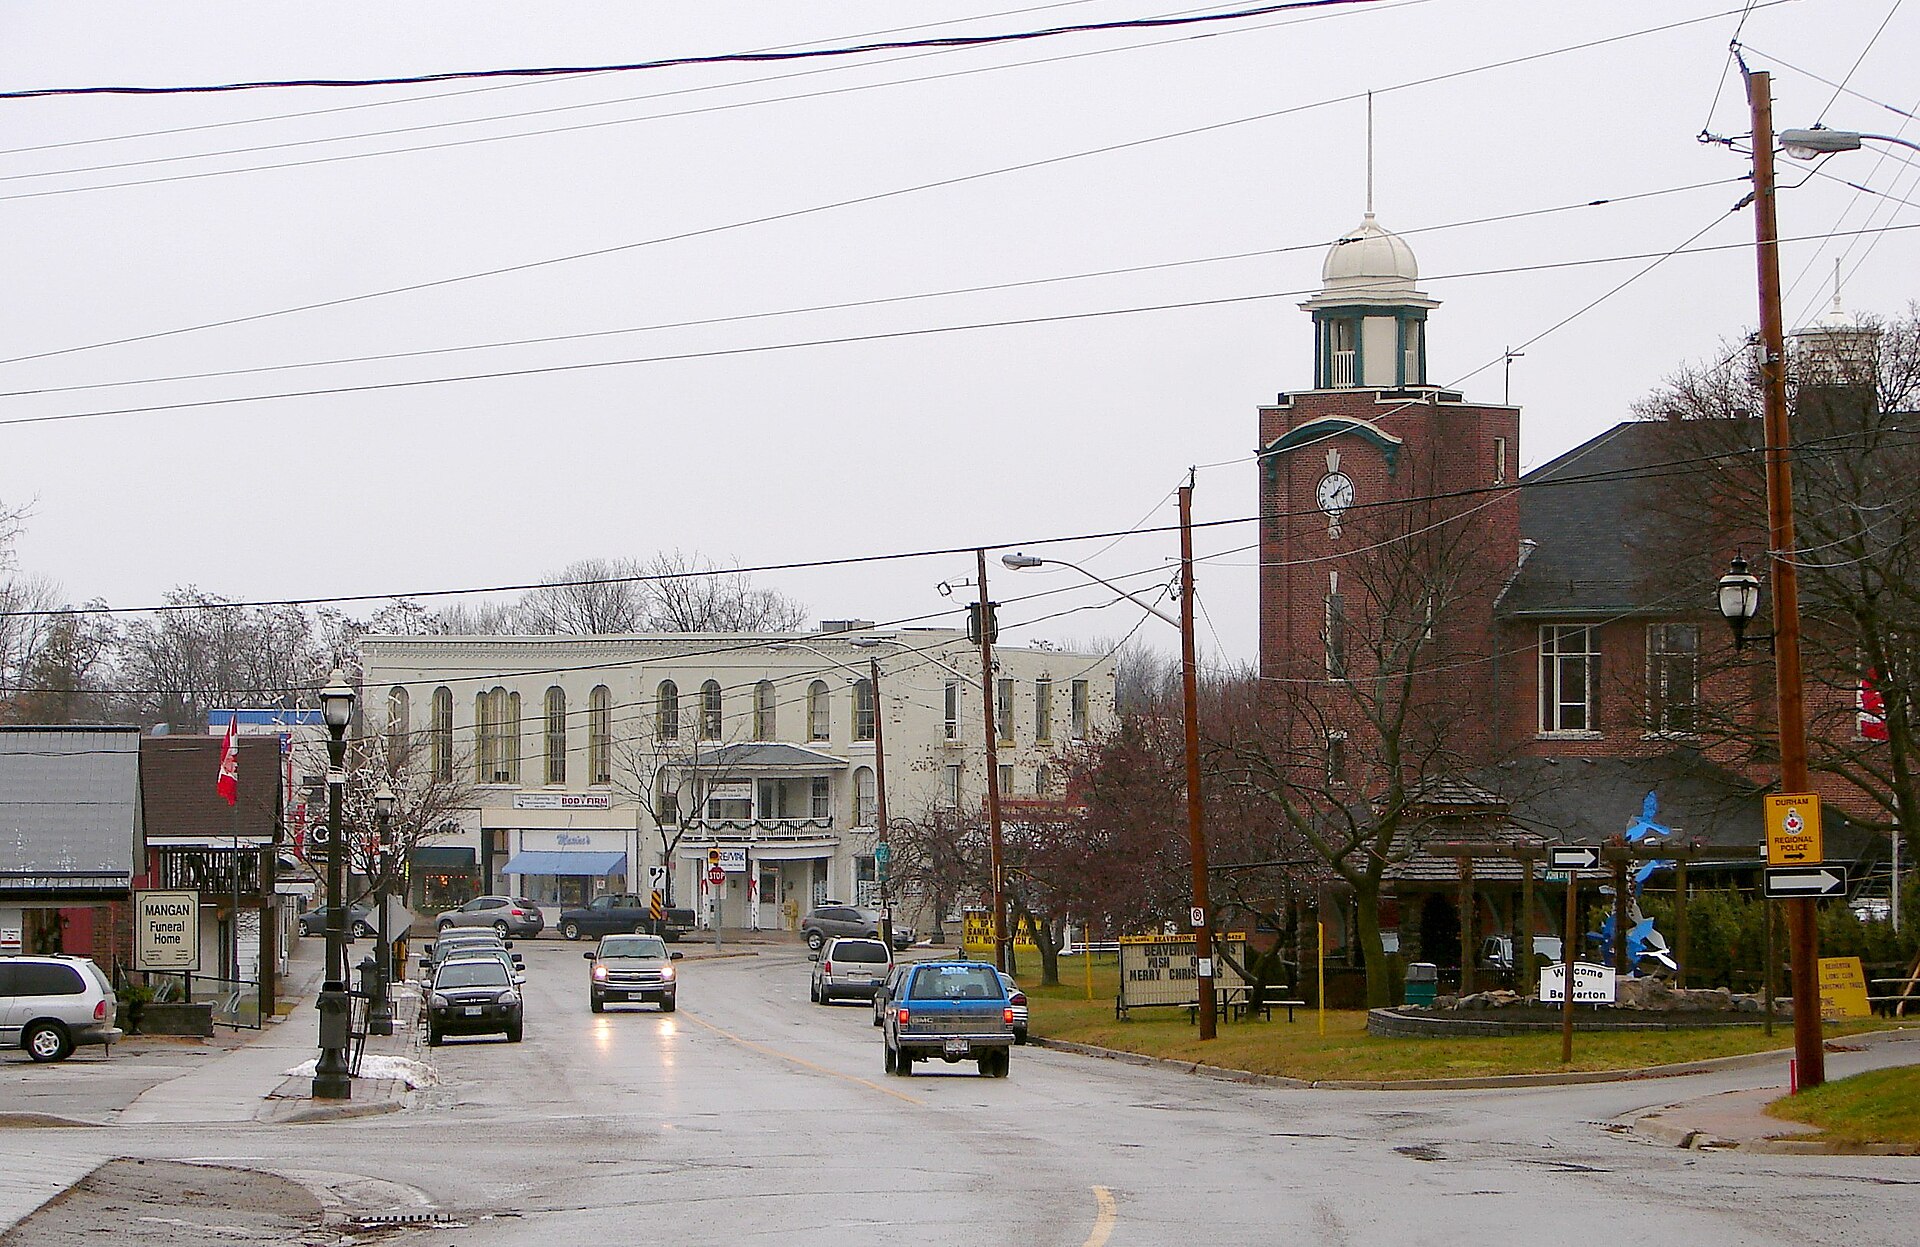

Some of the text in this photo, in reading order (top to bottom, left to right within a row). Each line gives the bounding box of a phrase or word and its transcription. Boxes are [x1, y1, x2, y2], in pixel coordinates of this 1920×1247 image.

[586, 797, 608, 805] FIRM
[1775, 798, 1809, 806] DURHAM
[1774, 836, 1813, 844] REGIONAL
[709, 871, 726, 880] STOP
[145, 904, 190, 916] MANGAN
[149, 920, 185, 932] Funeral
[968, 928, 990, 936] SANTA
[154, 933, 181, 944] Home
[966, 936, 979, 944] SAT
[1148, 957, 1170, 969] WISH
[1129, 970, 1161, 981] MERRY
[1553, 968, 1604, 979] Wcome
[1550, 989, 1606, 999] Beverton
